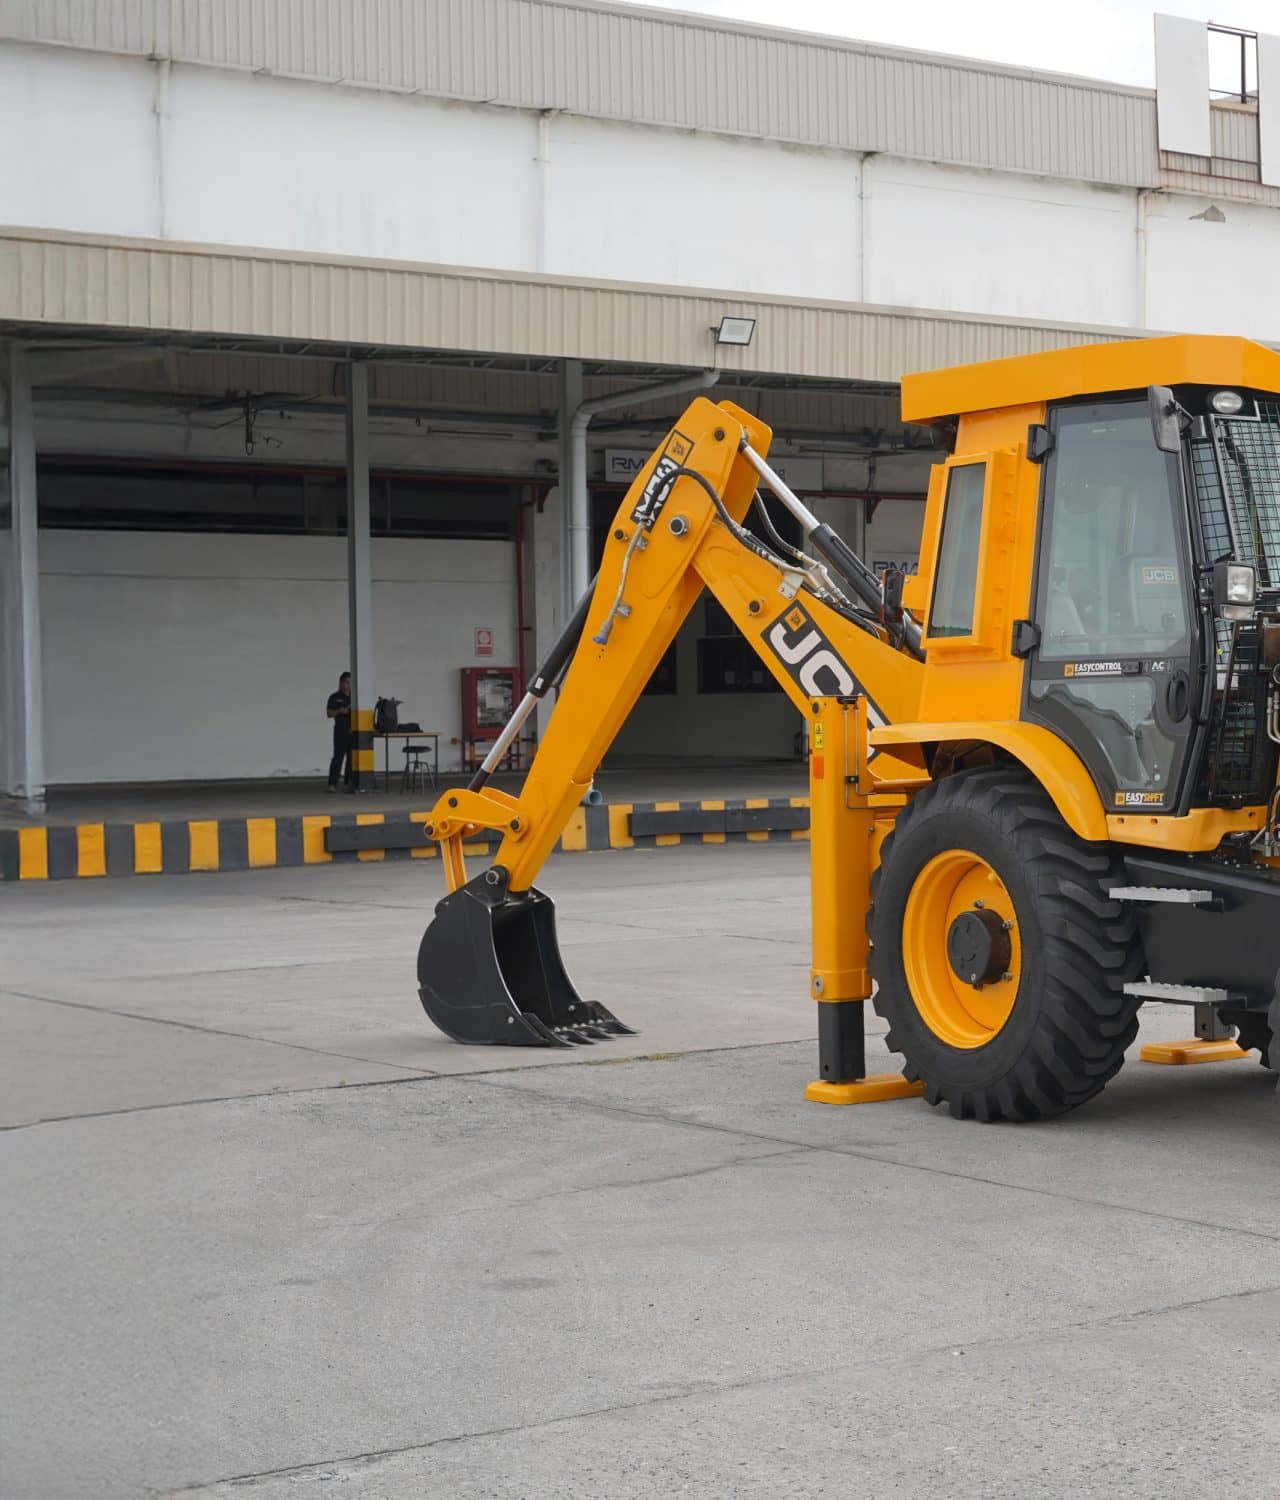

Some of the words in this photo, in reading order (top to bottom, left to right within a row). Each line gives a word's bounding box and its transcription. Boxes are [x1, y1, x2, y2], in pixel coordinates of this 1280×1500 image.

[612, 457, 645, 470] RM
[1147, 569, 1175, 581] JCB
[1075, 662, 1122, 672] EASYCONTROL
[1152, 661, 1165, 671] AC
